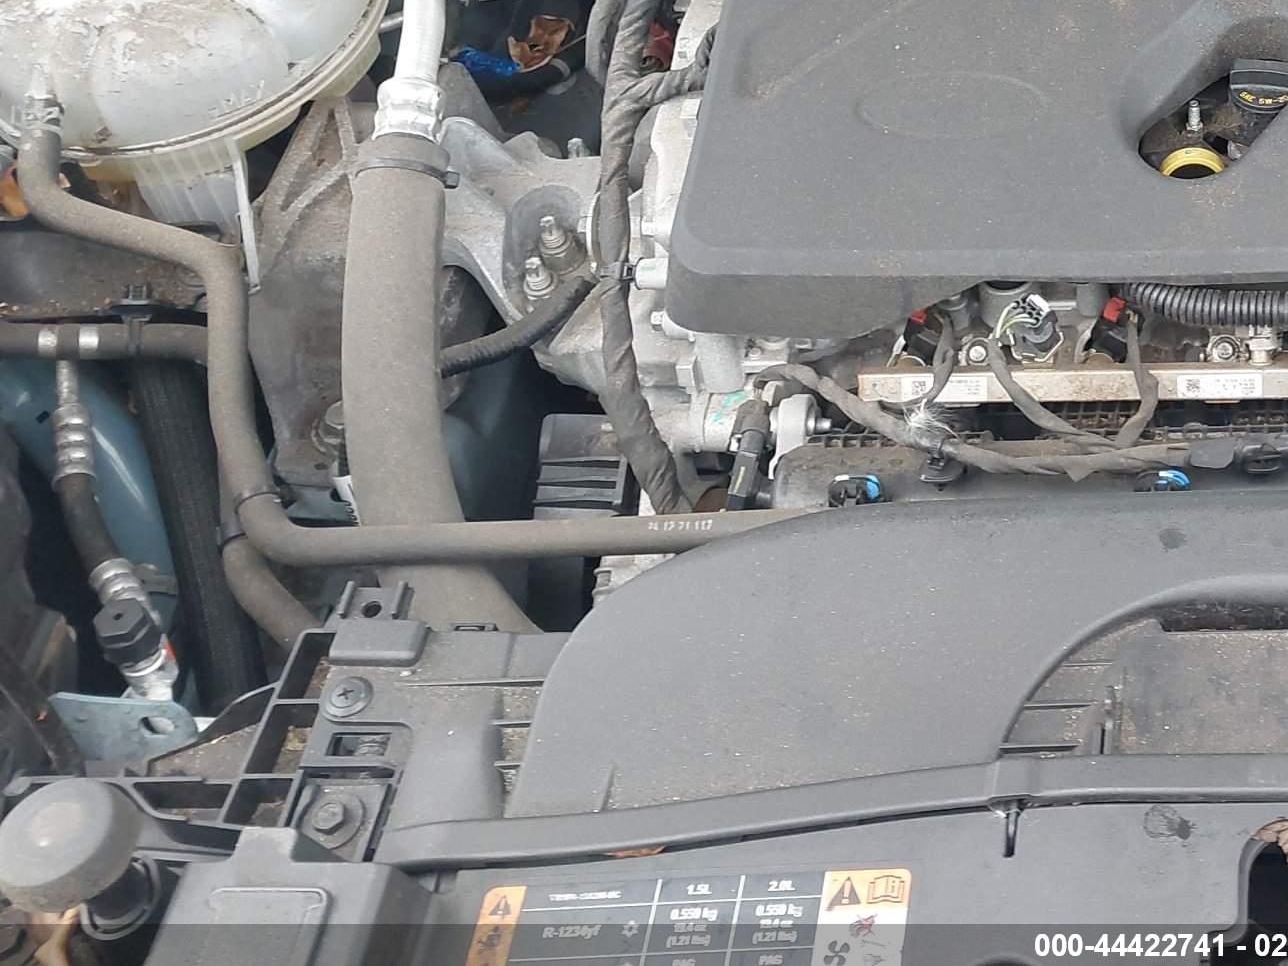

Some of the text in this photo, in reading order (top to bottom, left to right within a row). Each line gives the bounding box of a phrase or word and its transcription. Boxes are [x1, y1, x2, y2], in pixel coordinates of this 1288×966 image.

[1239, 91, 1257, 103] SAE
[686, 880, 796, 895] 1.5L 2.0L
[701, 907, 719, 921] kg
[786, 903, 804, 917] kg
[542, 924, 602, 939] R-1234yf
[776, 930, 798, 943] lbs)
[690, 934, 712, 947] lbs)
